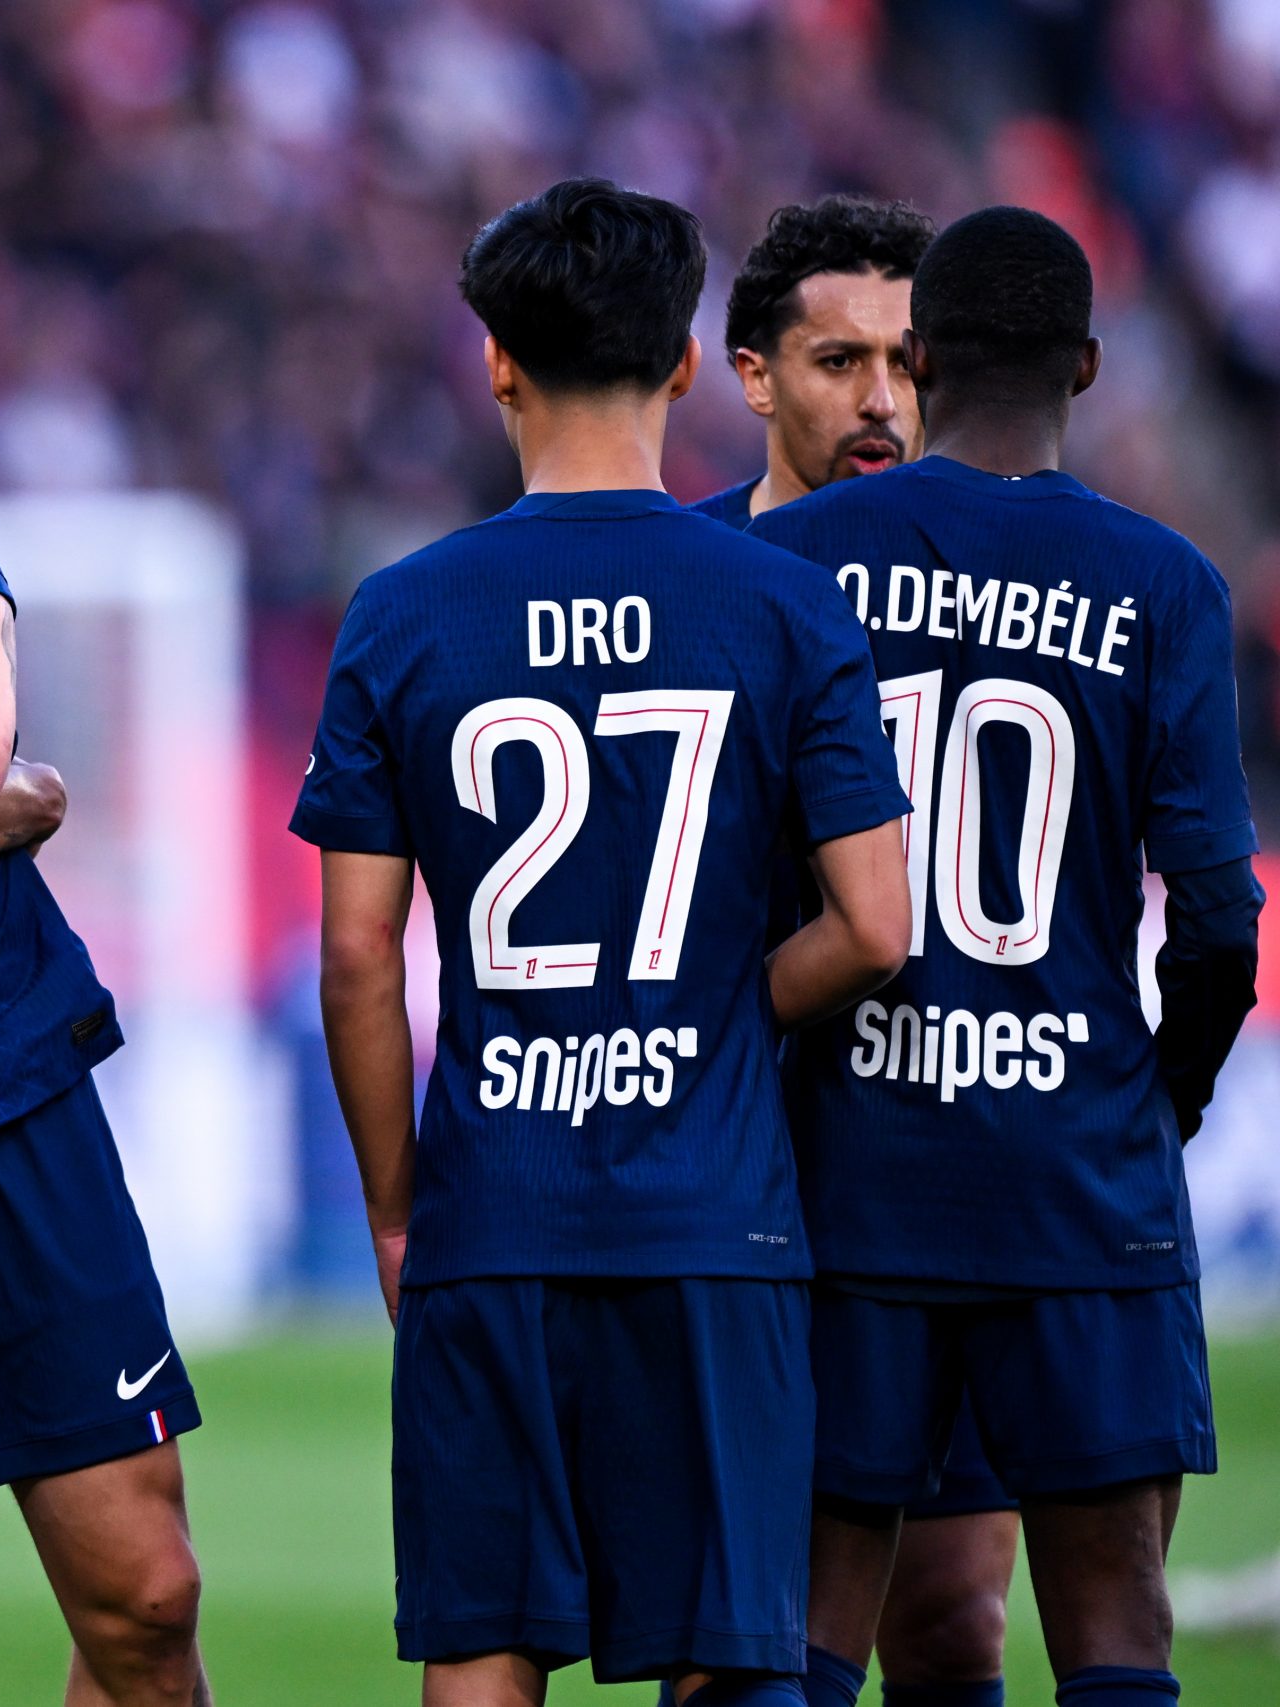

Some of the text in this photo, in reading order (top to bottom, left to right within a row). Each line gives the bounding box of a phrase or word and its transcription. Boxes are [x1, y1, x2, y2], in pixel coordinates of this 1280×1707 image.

[526, 595, 652, 667] DRO
[450, 688, 736, 990] 27
[877, 668, 1076, 966] 10
[479, 1027, 678, 1127] snipes
[850, 1000, 1066, 1103] snipes
